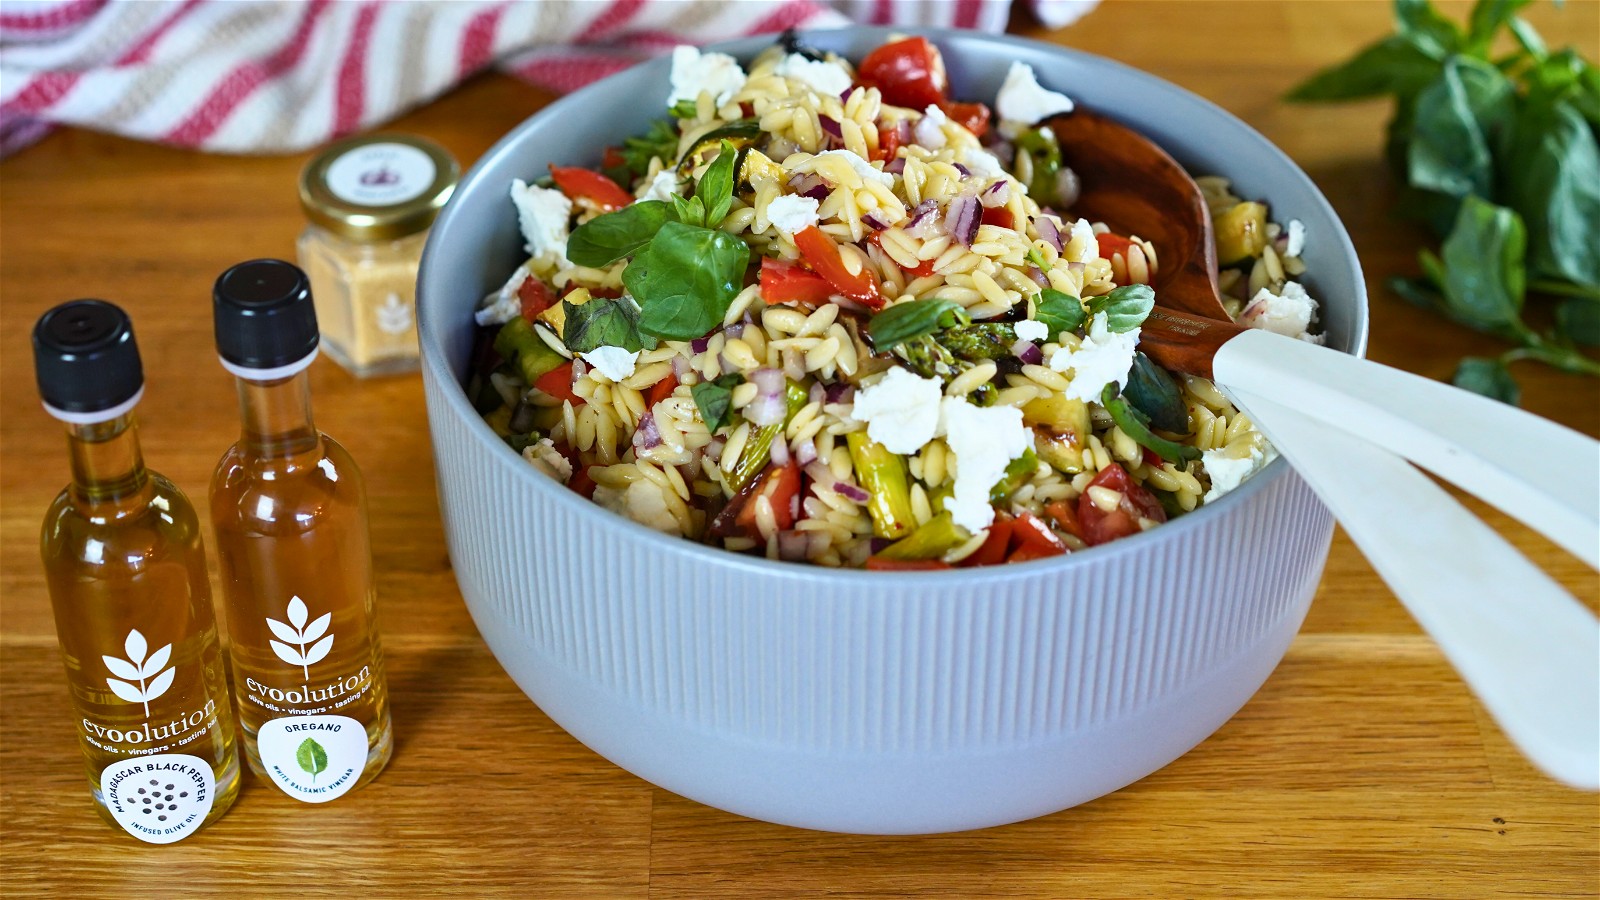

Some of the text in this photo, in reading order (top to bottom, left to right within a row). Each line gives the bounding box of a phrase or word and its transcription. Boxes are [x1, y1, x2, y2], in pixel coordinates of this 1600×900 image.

[246, 665, 371, 704] evoolution
[248, 681, 372, 716] olive oils vinegars tasting bar
[83, 699, 216, 744] evoolution
[86, 716, 218, 755] olive oils vinegars tasting bar
[284, 723, 342, 733] OREGANO
[109, 763, 206, 813] MADAGASCAR BLACK PEPPER
[273, 765, 354, 794] WHITE BALSAMIC VINEGAR
[131, 813, 198, 835] INFUSED OLIVE OIL
